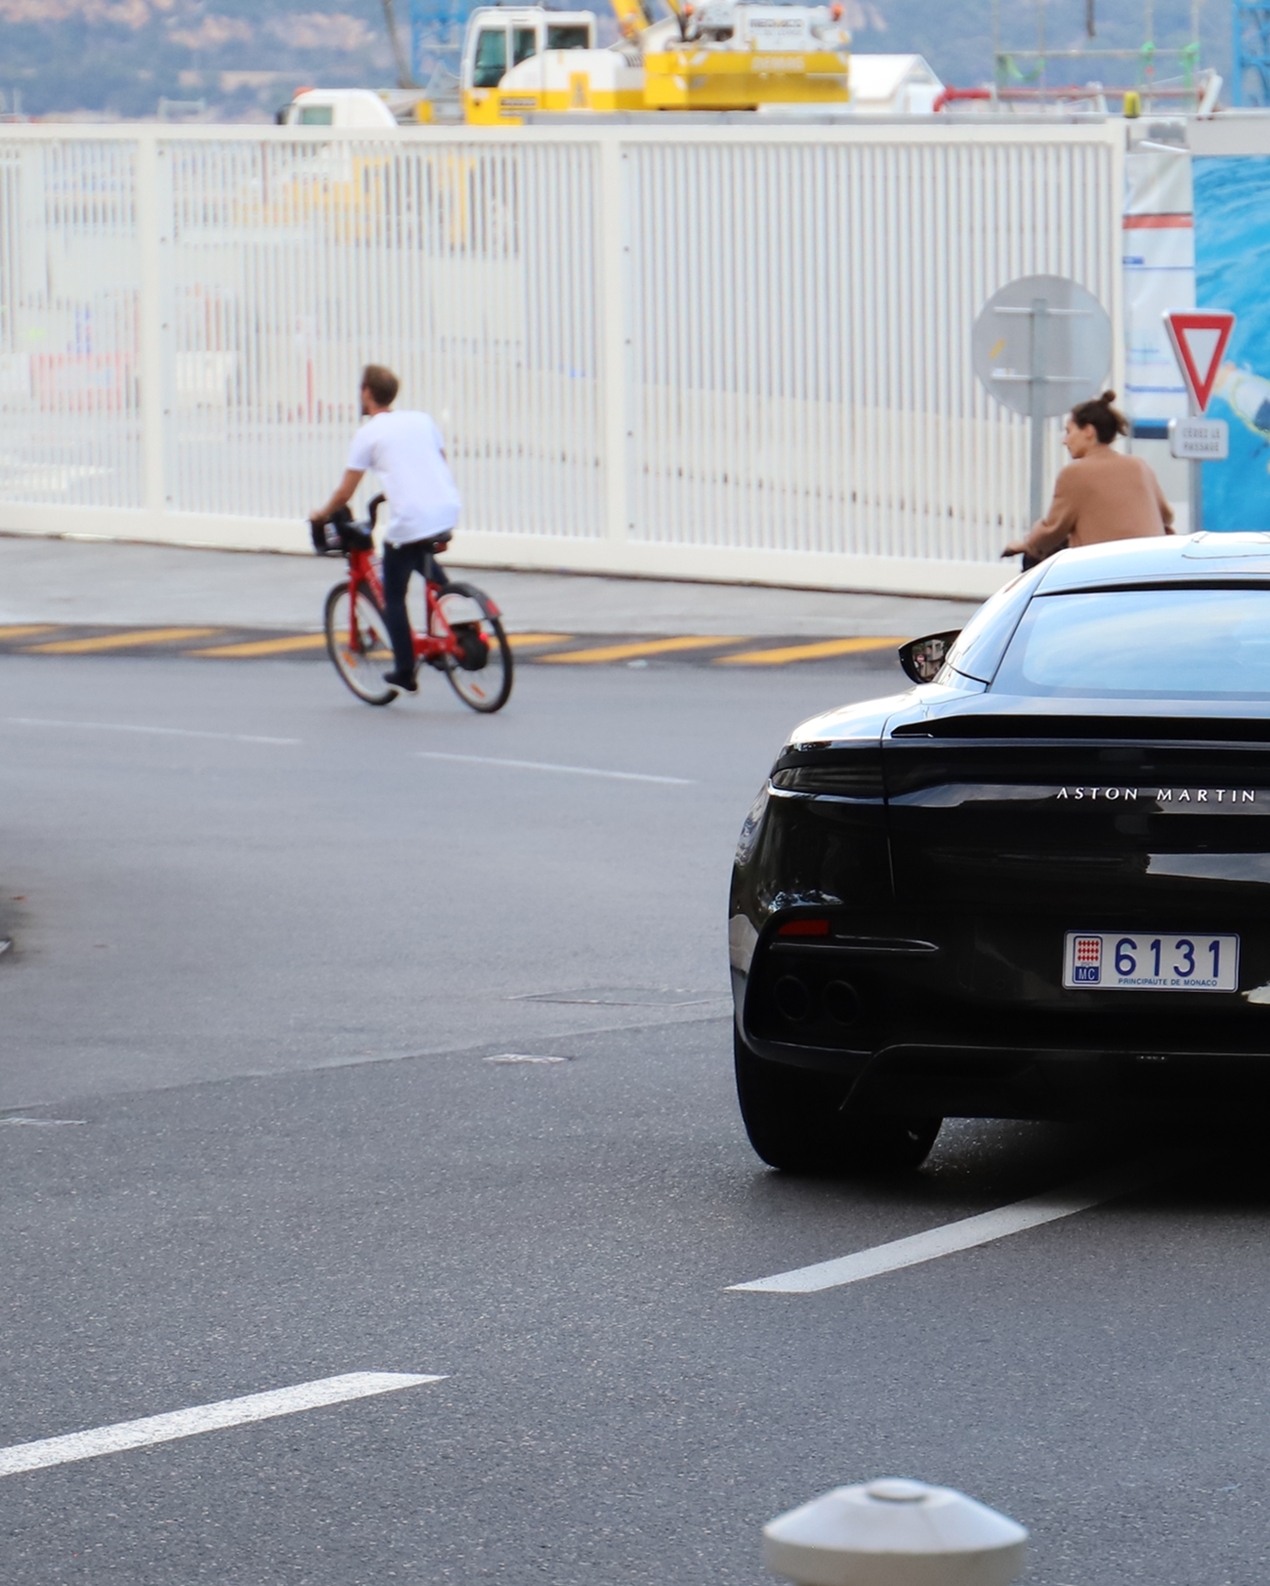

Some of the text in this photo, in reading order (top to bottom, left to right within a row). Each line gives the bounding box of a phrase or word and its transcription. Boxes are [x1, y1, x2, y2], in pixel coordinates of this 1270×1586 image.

[1056, 786, 1256, 803] ASTON MARTIN
[1114, 937, 1221, 979] 6131
[1078, 968, 1095, 980] MC
[1184, 979, 1217, 987] MONACO
